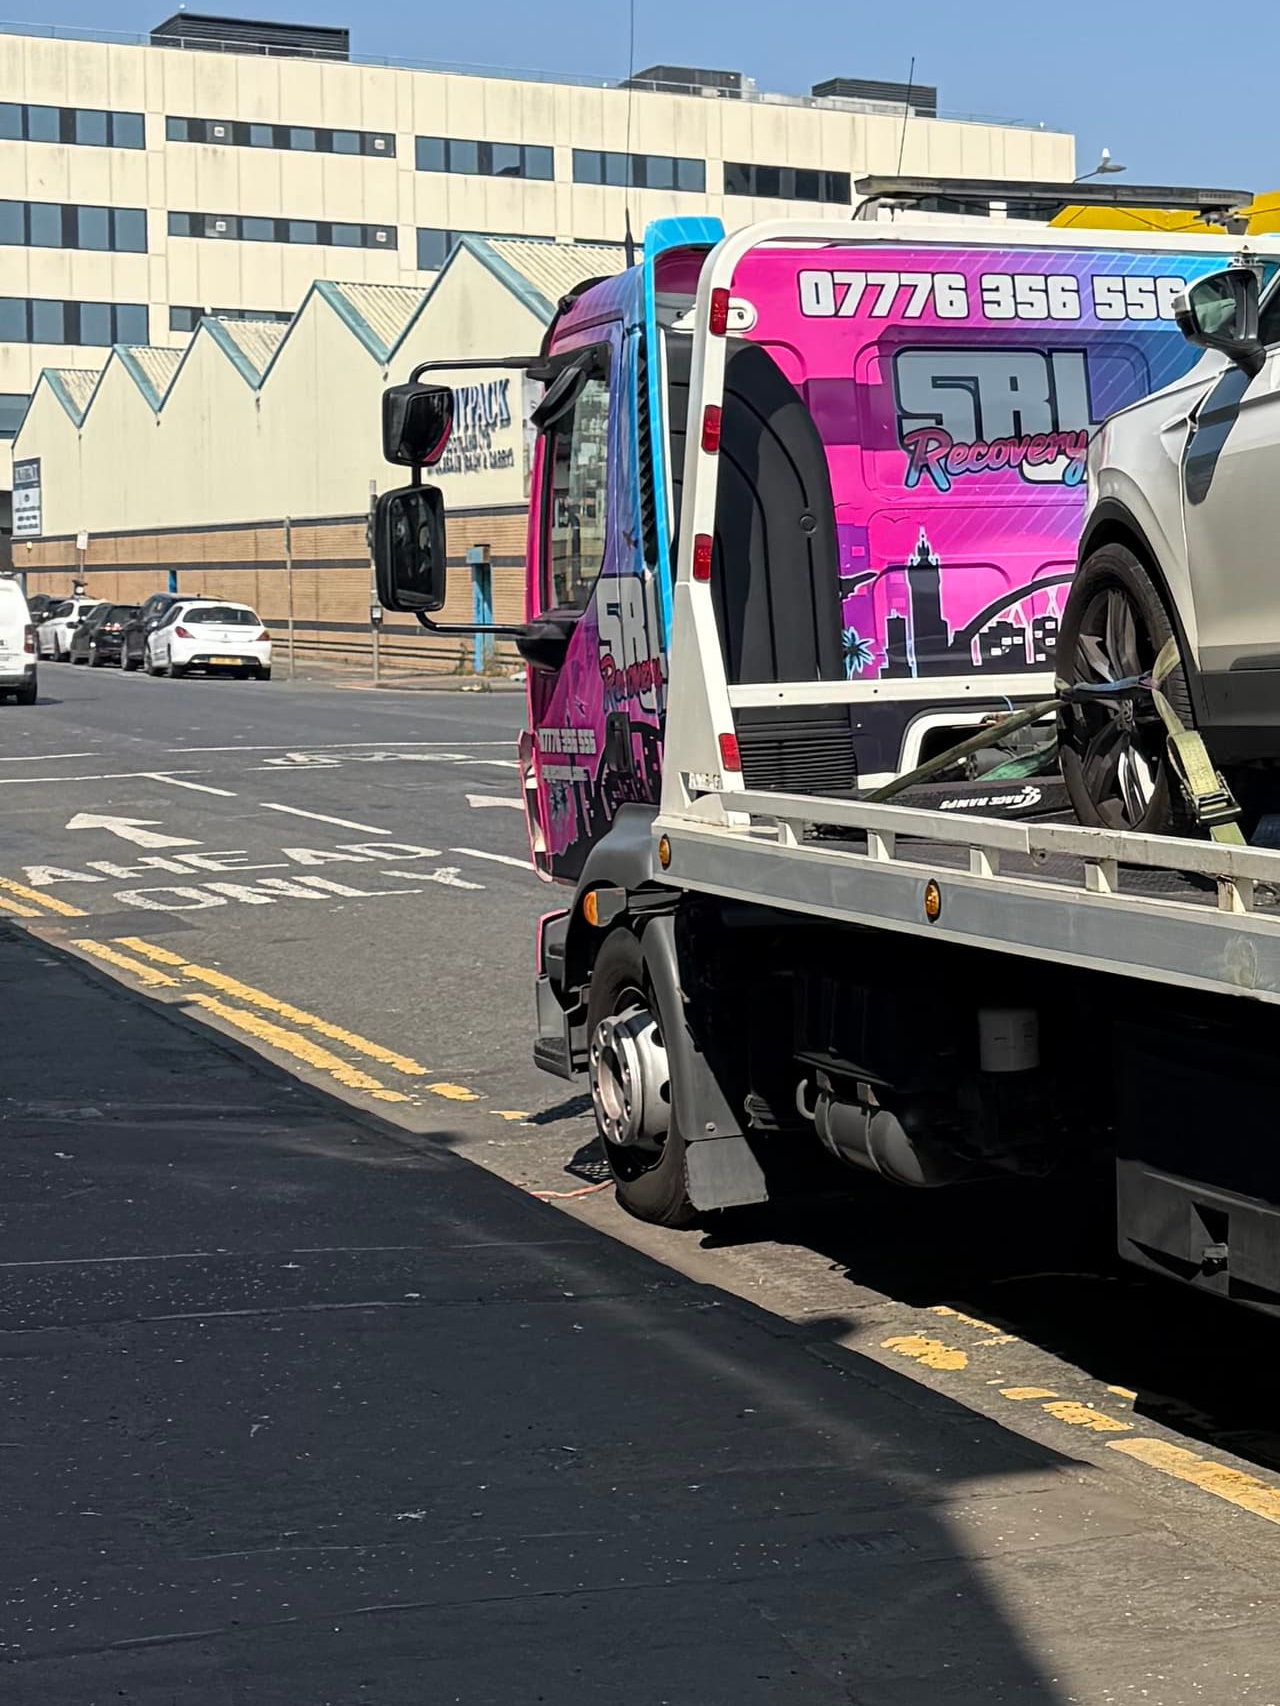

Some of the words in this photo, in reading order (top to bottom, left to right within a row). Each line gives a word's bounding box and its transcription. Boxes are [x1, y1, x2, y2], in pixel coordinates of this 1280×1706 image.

[798, 269, 970, 319] 07776
[980, 272, 1081, 320] 356
[1091, 274, 1188, 321] 556
[903, 426, 1089, 493] Recovery
[938, 796, 989, 810] RAMPS
[22, 841, 443, 887] AHEAD
[112, 867, 486, 913] ONLY
